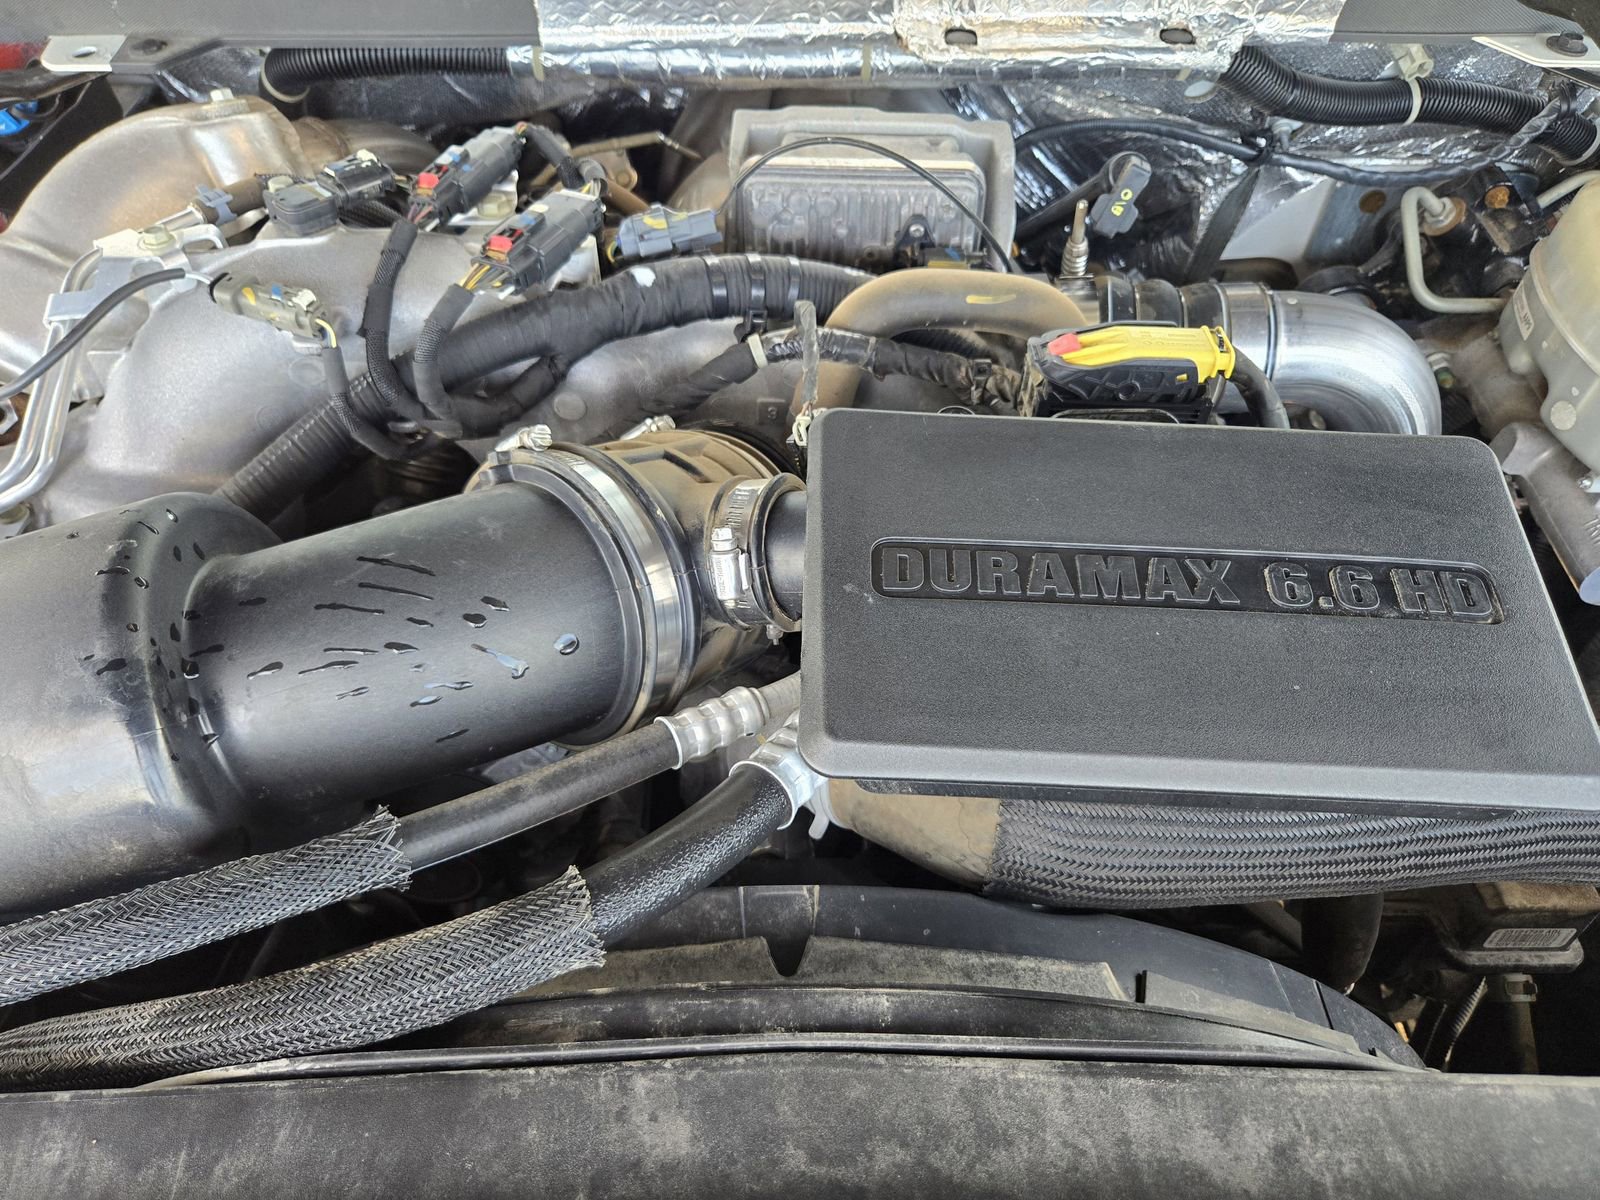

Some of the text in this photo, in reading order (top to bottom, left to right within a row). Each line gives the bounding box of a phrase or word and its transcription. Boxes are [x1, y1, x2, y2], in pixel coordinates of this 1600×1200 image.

[881, 547, 1493, 616] DURAMAX 6.6 HD
